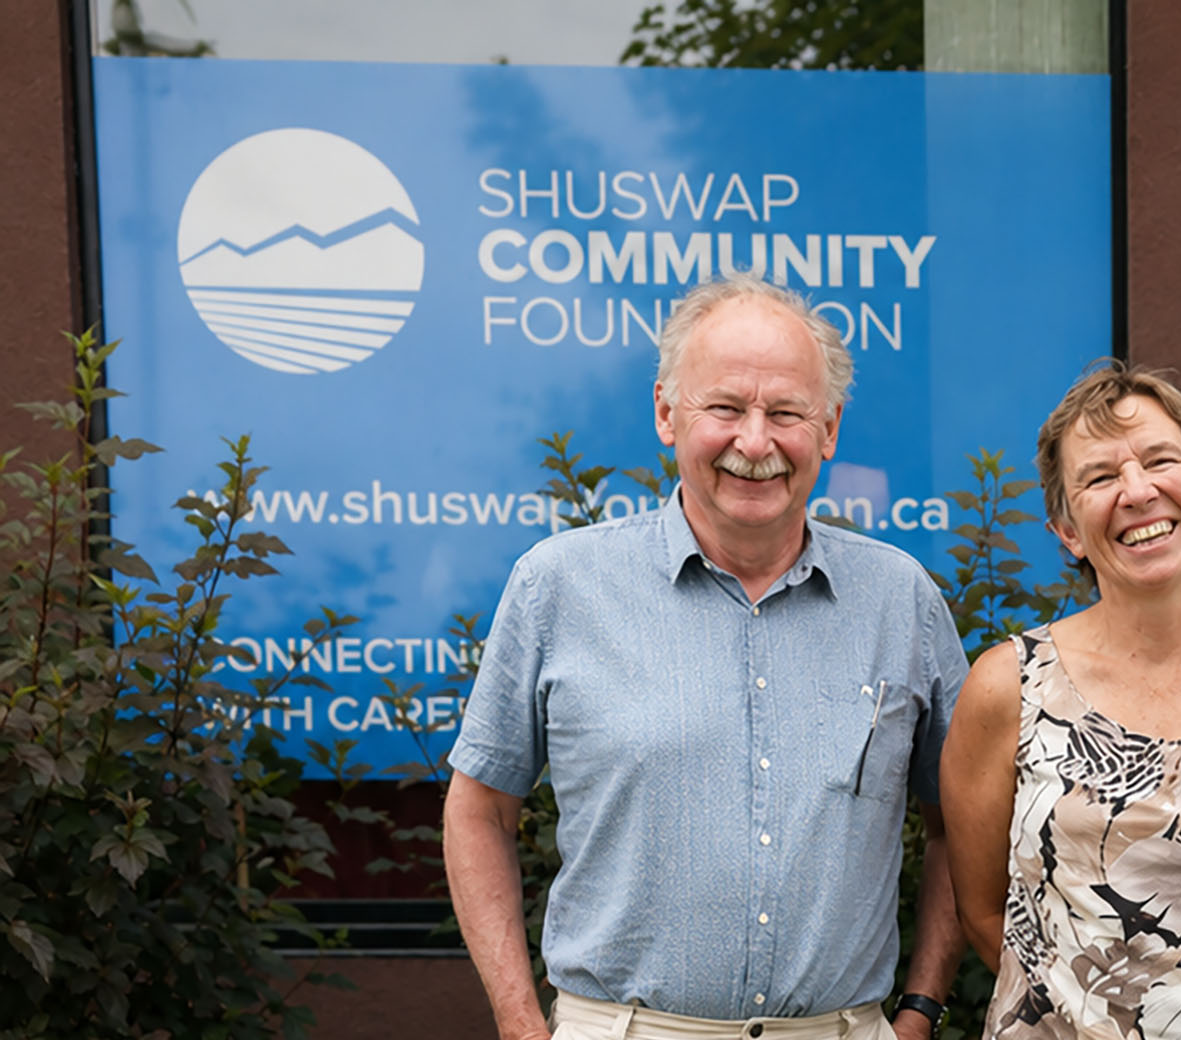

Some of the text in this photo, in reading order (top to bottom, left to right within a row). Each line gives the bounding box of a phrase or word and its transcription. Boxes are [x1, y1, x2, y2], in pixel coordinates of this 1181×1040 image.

[478, 168, 800, 222] SHUSWAP
[477, 228, 937, 288] COMMUNITY
[483, 296, 902, 351] FOUNON
[327, 696, 467, 732] CARE
